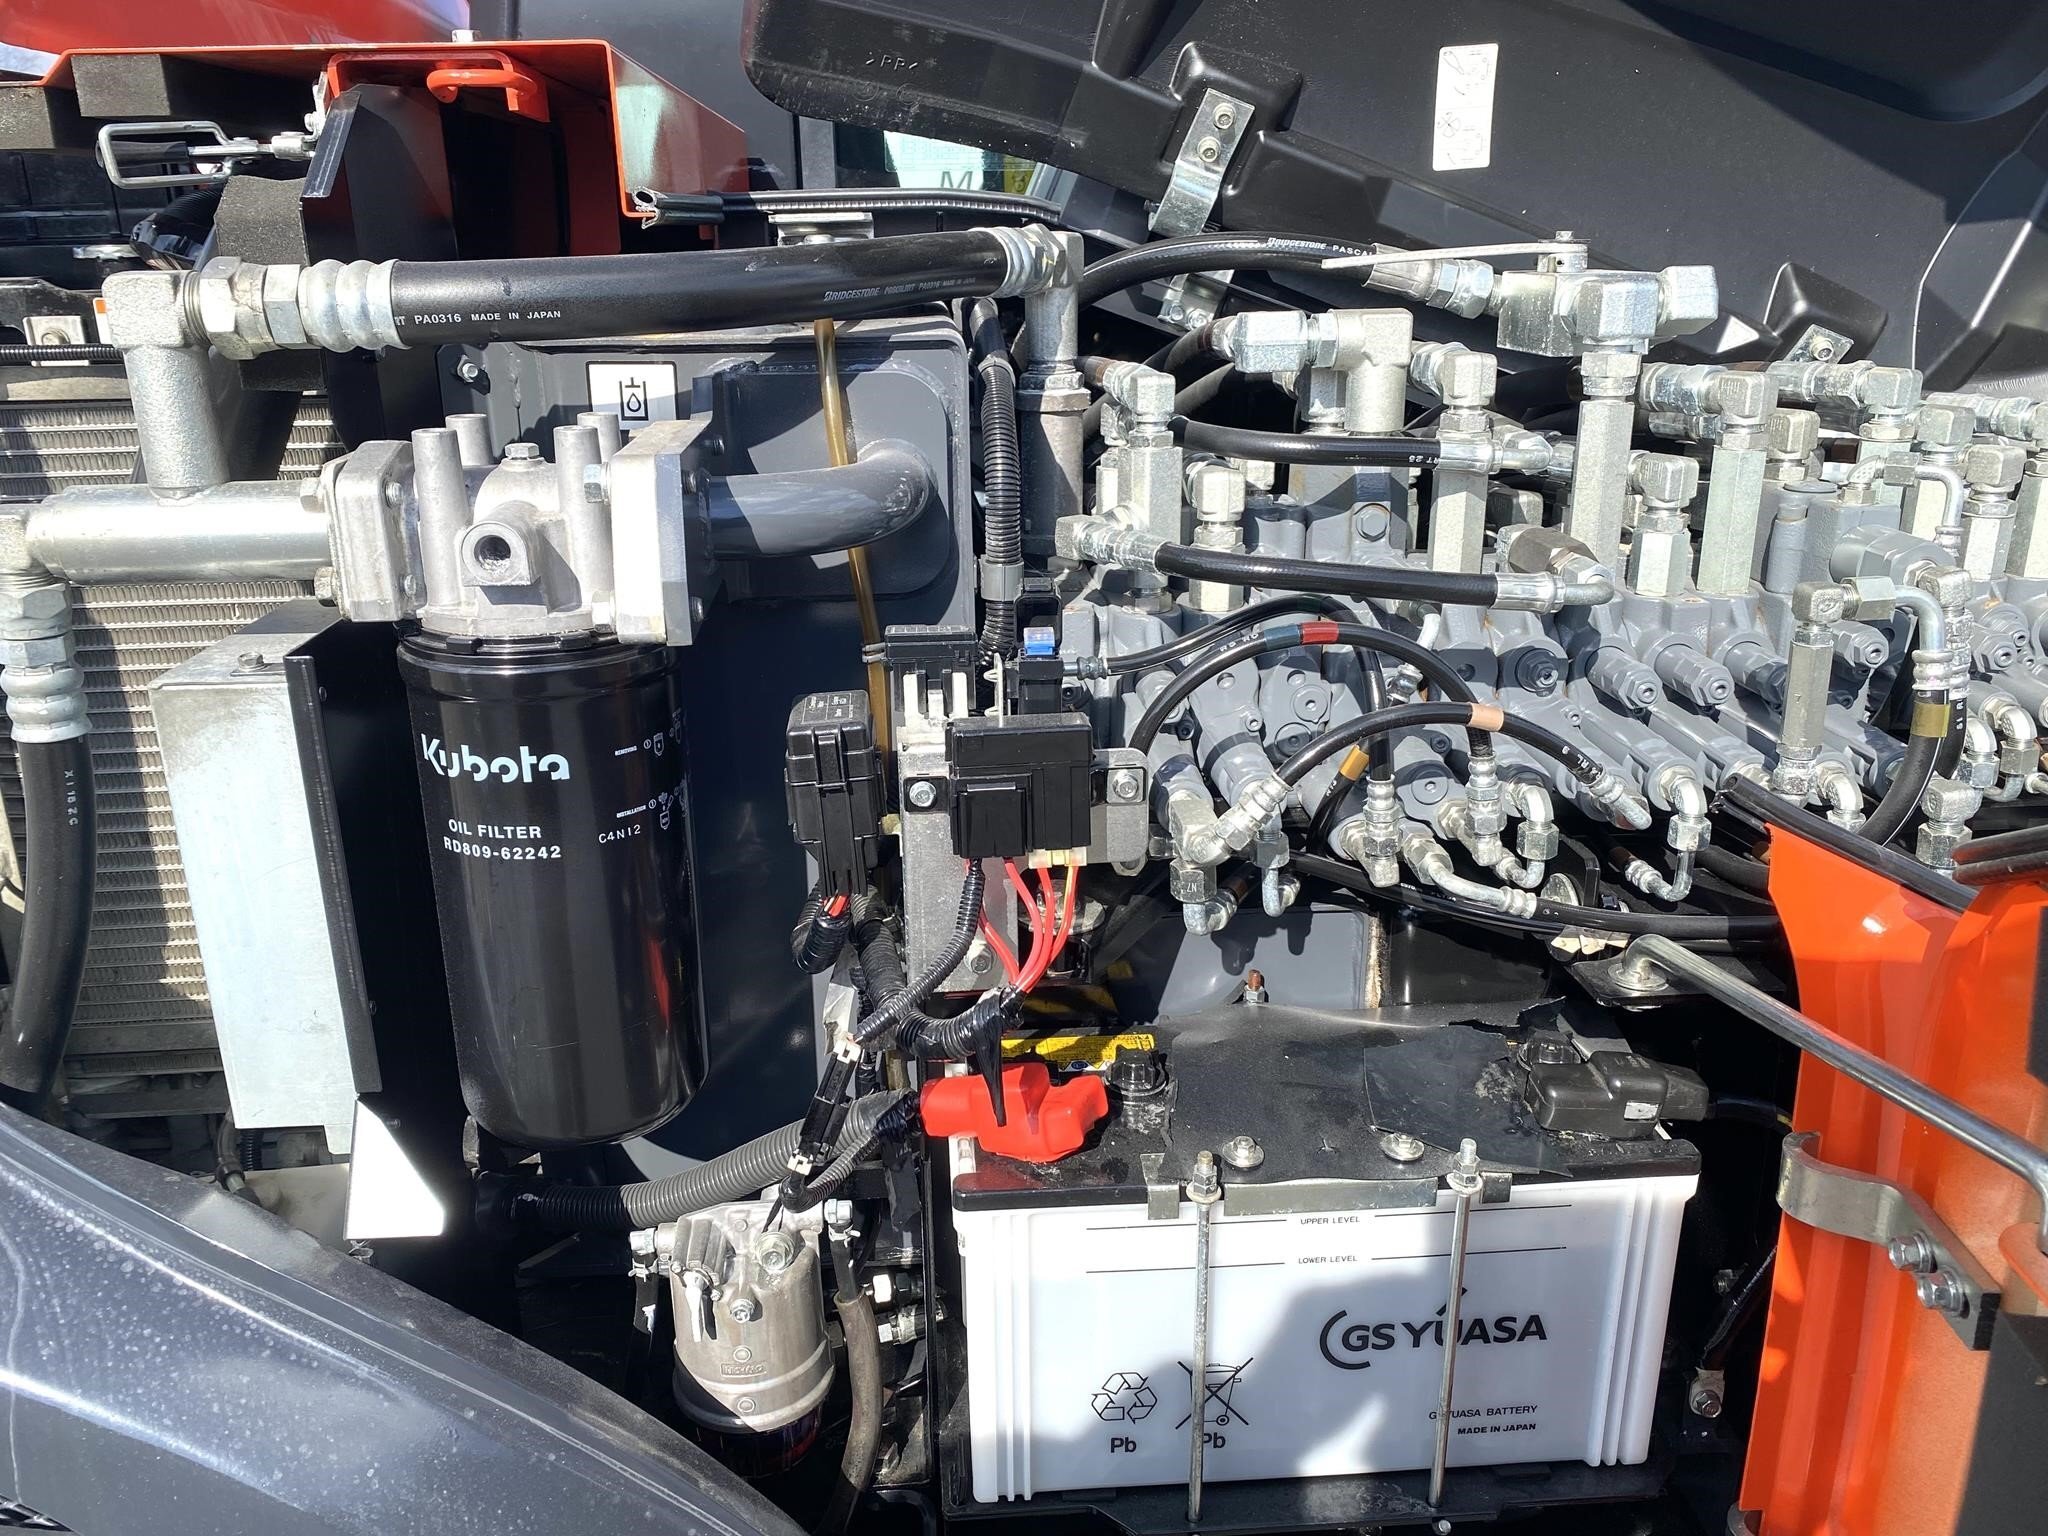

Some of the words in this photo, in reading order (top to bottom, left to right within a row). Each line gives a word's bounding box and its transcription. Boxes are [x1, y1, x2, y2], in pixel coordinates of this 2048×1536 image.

[1267, 237, 1327, 250] BRIDGESTONE
[823, 286, 881, 302] BRIDGESTONE
[414, 313, 462, 325] PA0316
[470, 312, 501, 322] MADE
[508, 312, 519, 320] IN
[526, 310, 561, 320] JAPAN
[420, 733, 571, 783] Kubota
[448, 819, 473, 835] OIL
[477, 824, 542, 839] FILTER
[443, 836, 562, 860] RD809-62242
[1300, 1217, 1329, 1225] UPPER
[1332, 1216, 1360, 1224] LEVEL
[1298, 1256, 1327, 1265] LOWER
[1329, 1255, 1358, 1263] LEVEL
[1486, 1404, 1538, 1417] BATTERY
[1457, 1426, 1488, 1435] MADE
[1490, 1425, 1501, 1433] IN
[1503, 1423, 1537, 1432] JAPAN
[1110, 1437, 1137, 1453] Pb
